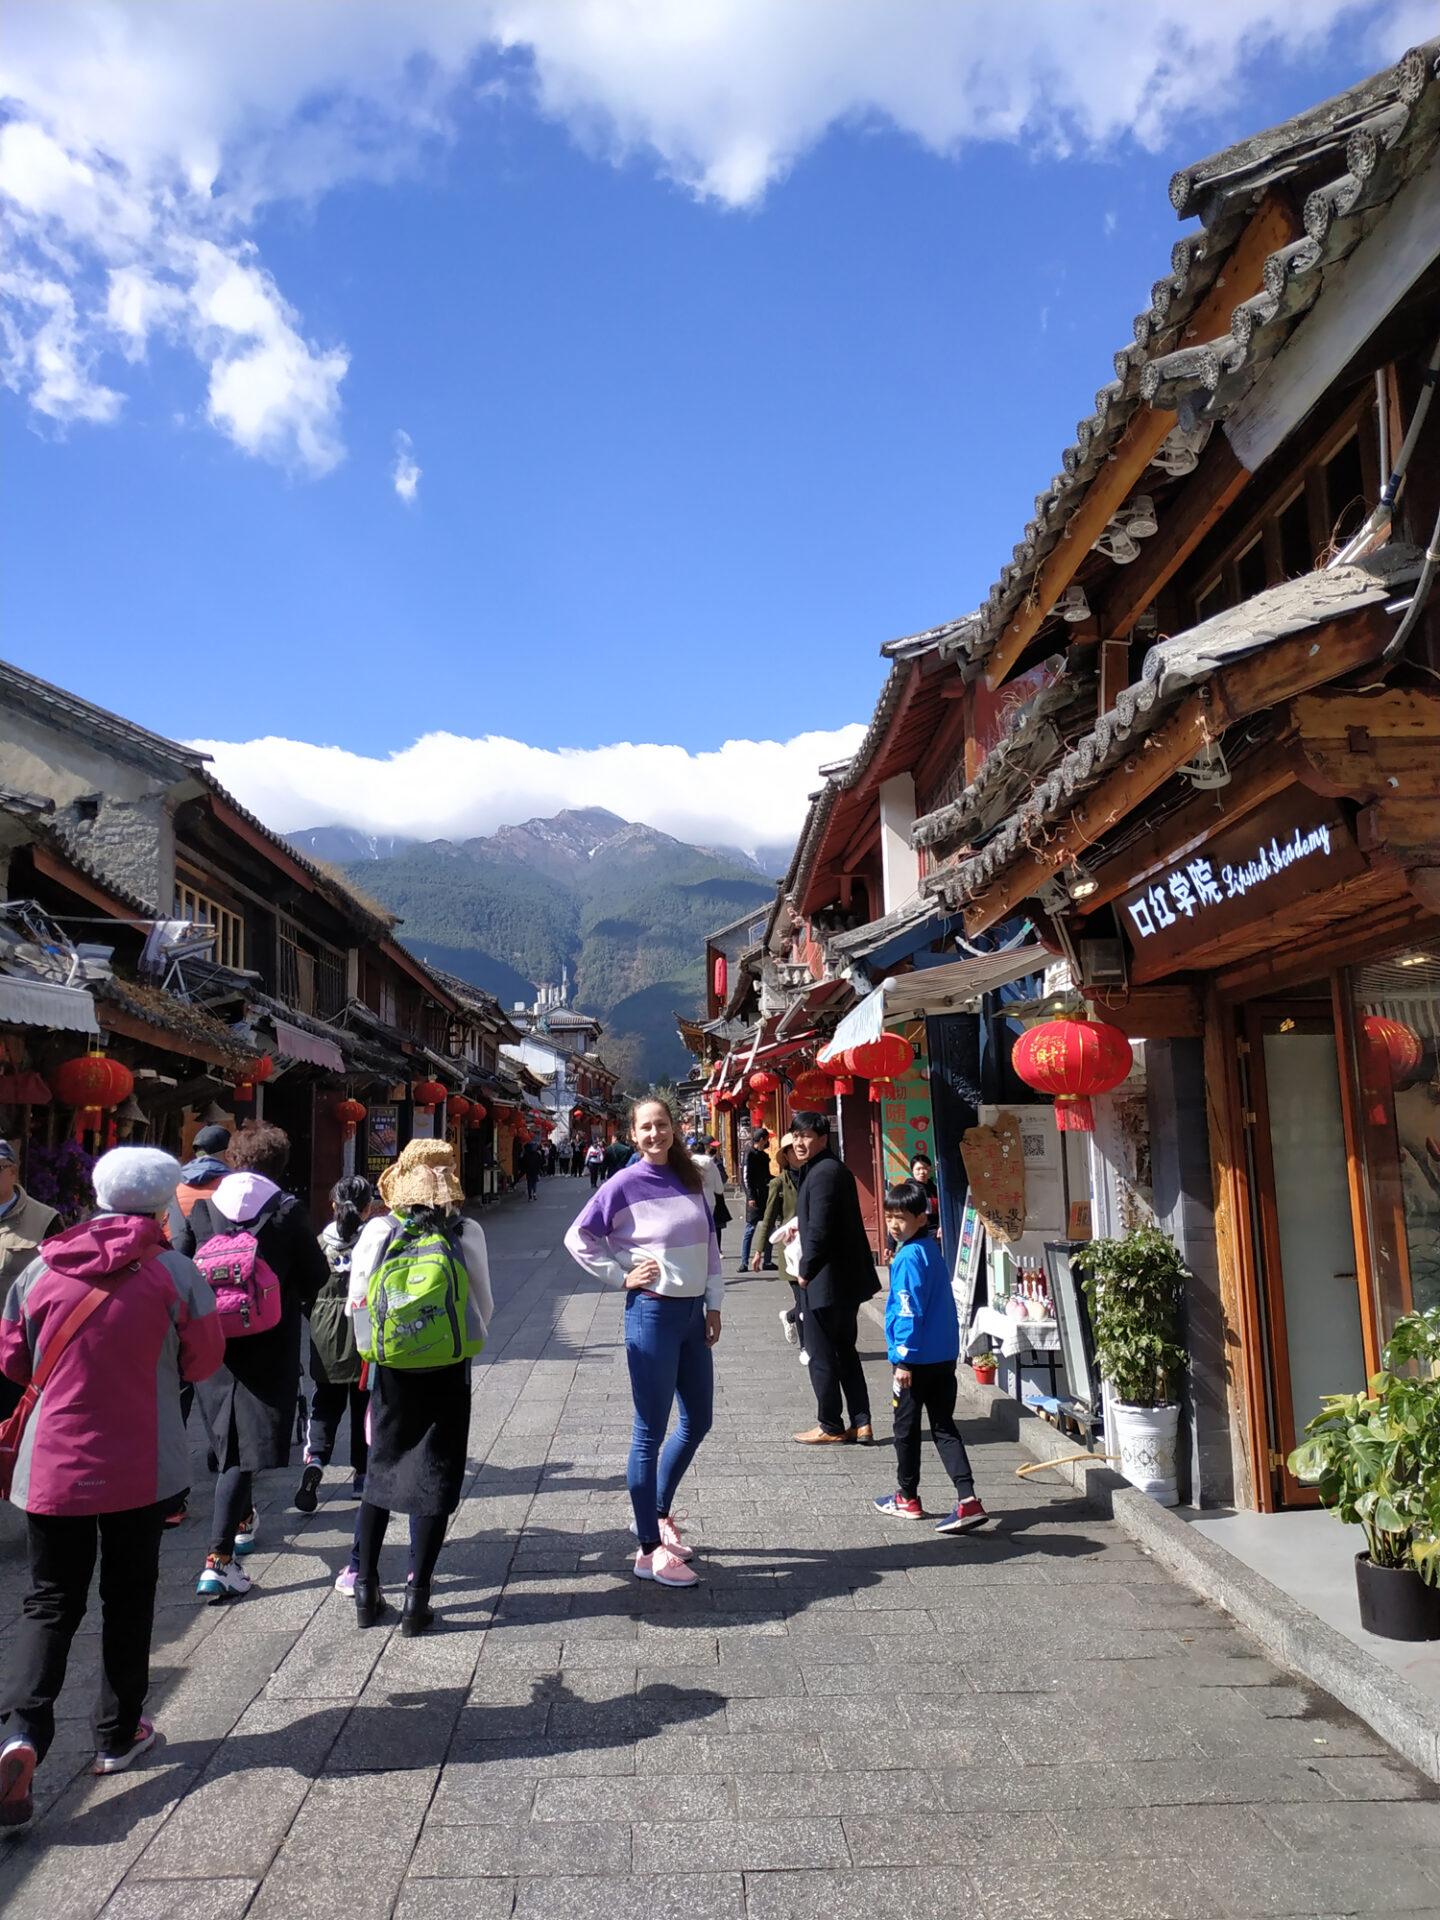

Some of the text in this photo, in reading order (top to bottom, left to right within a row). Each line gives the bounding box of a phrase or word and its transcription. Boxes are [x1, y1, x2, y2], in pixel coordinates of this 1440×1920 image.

[1128, 858, 1224, 938] 口红学院
[1269, 824, 1330, 873] Academy
